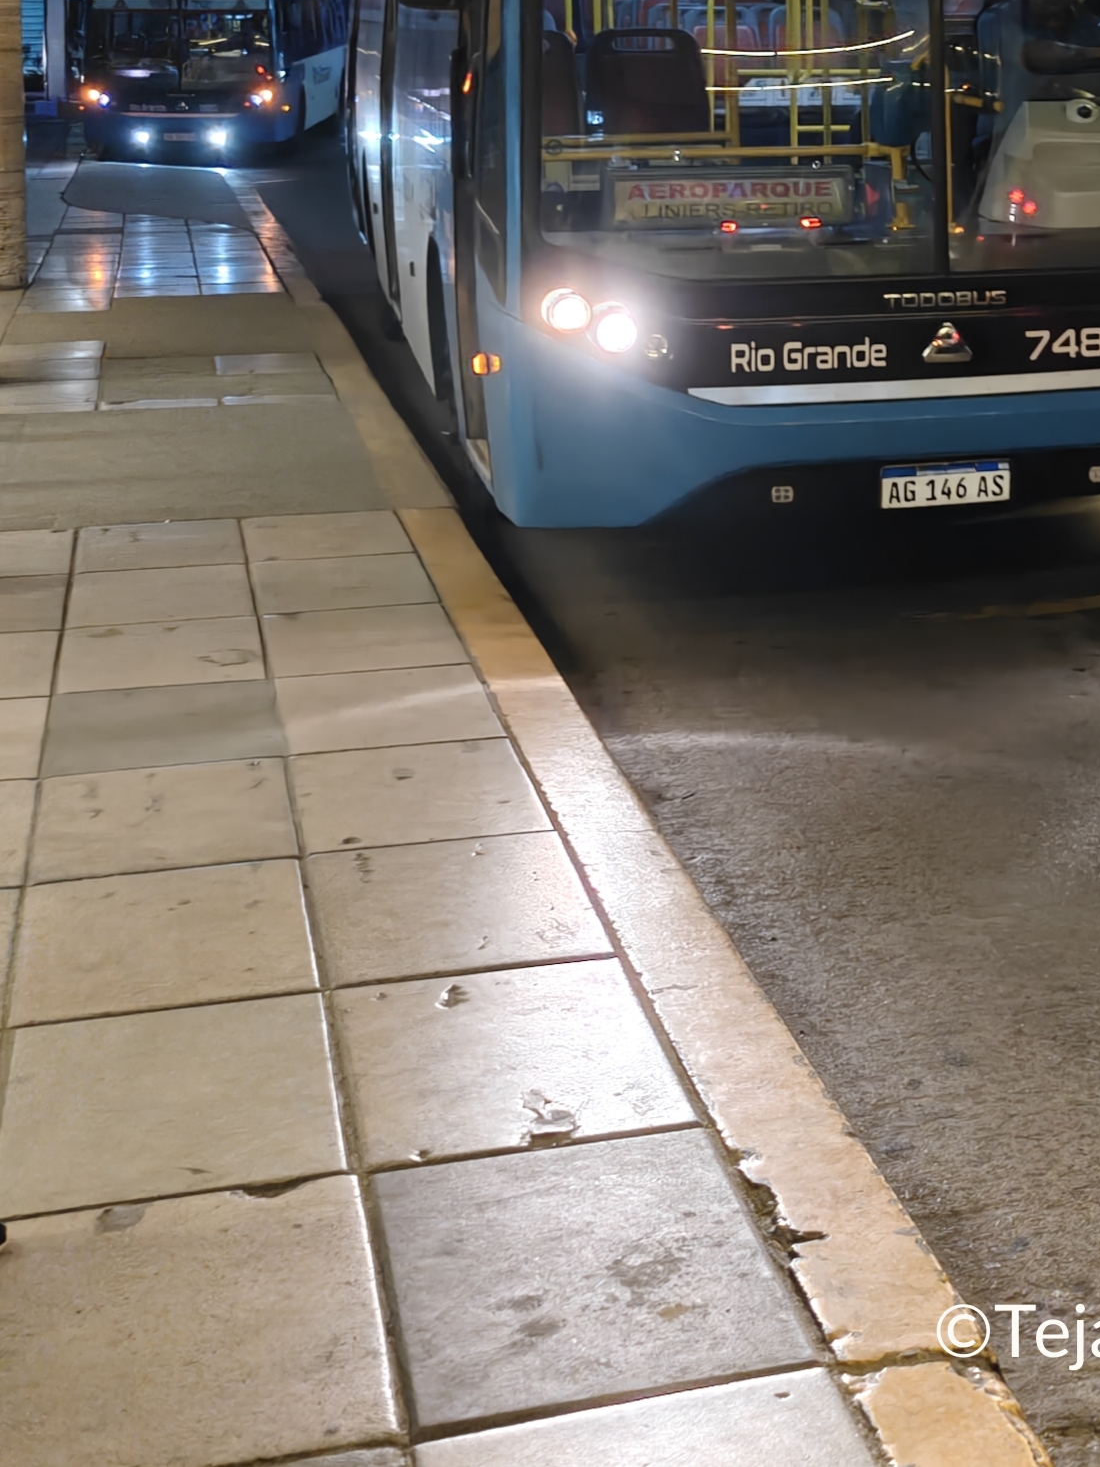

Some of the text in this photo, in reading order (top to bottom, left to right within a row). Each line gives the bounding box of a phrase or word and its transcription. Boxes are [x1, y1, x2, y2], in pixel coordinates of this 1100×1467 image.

[628, 180, 833, 201] AEROPARQUE
[883, 290, 1006, 309] TODOBUS
[730, 337, 887, 373] Rio Grande
[889, 474, 1004, 505] AG 146 AS
